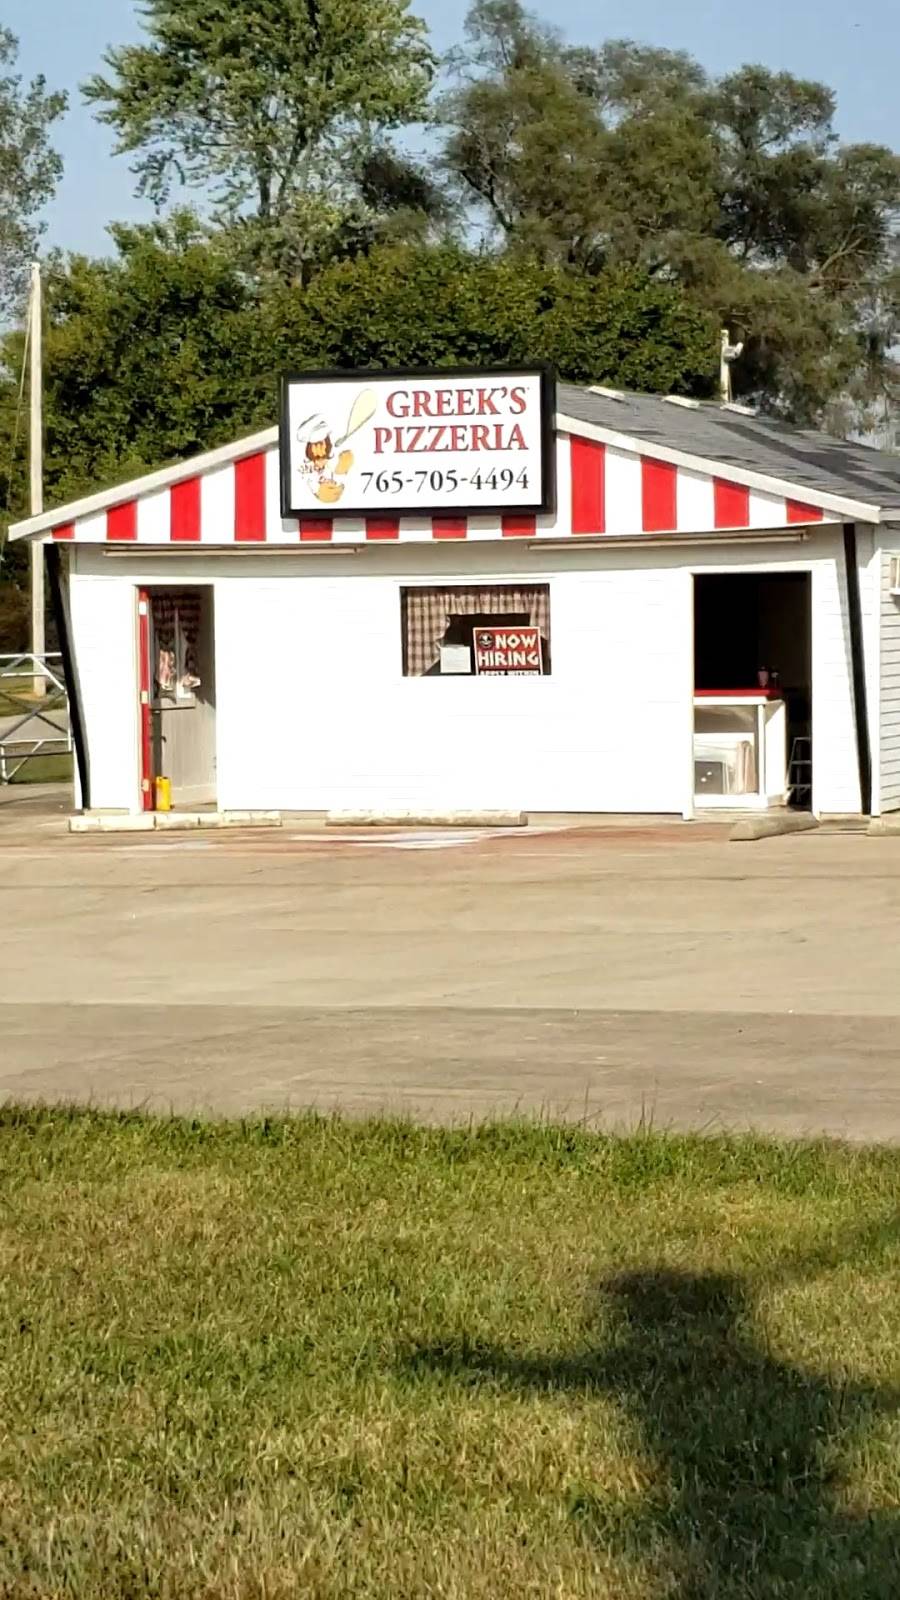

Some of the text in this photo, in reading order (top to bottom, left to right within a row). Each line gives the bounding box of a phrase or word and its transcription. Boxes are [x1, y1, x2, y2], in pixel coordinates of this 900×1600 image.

[386, 386, 527, 418] GREEK'S
[373, 423, 529, 454] PIZZERIA
[360, 466, 529, 494] 765-705-4494
[495, 634, 537, 649] NOW
[478, 651, 539, 667] HIRING
